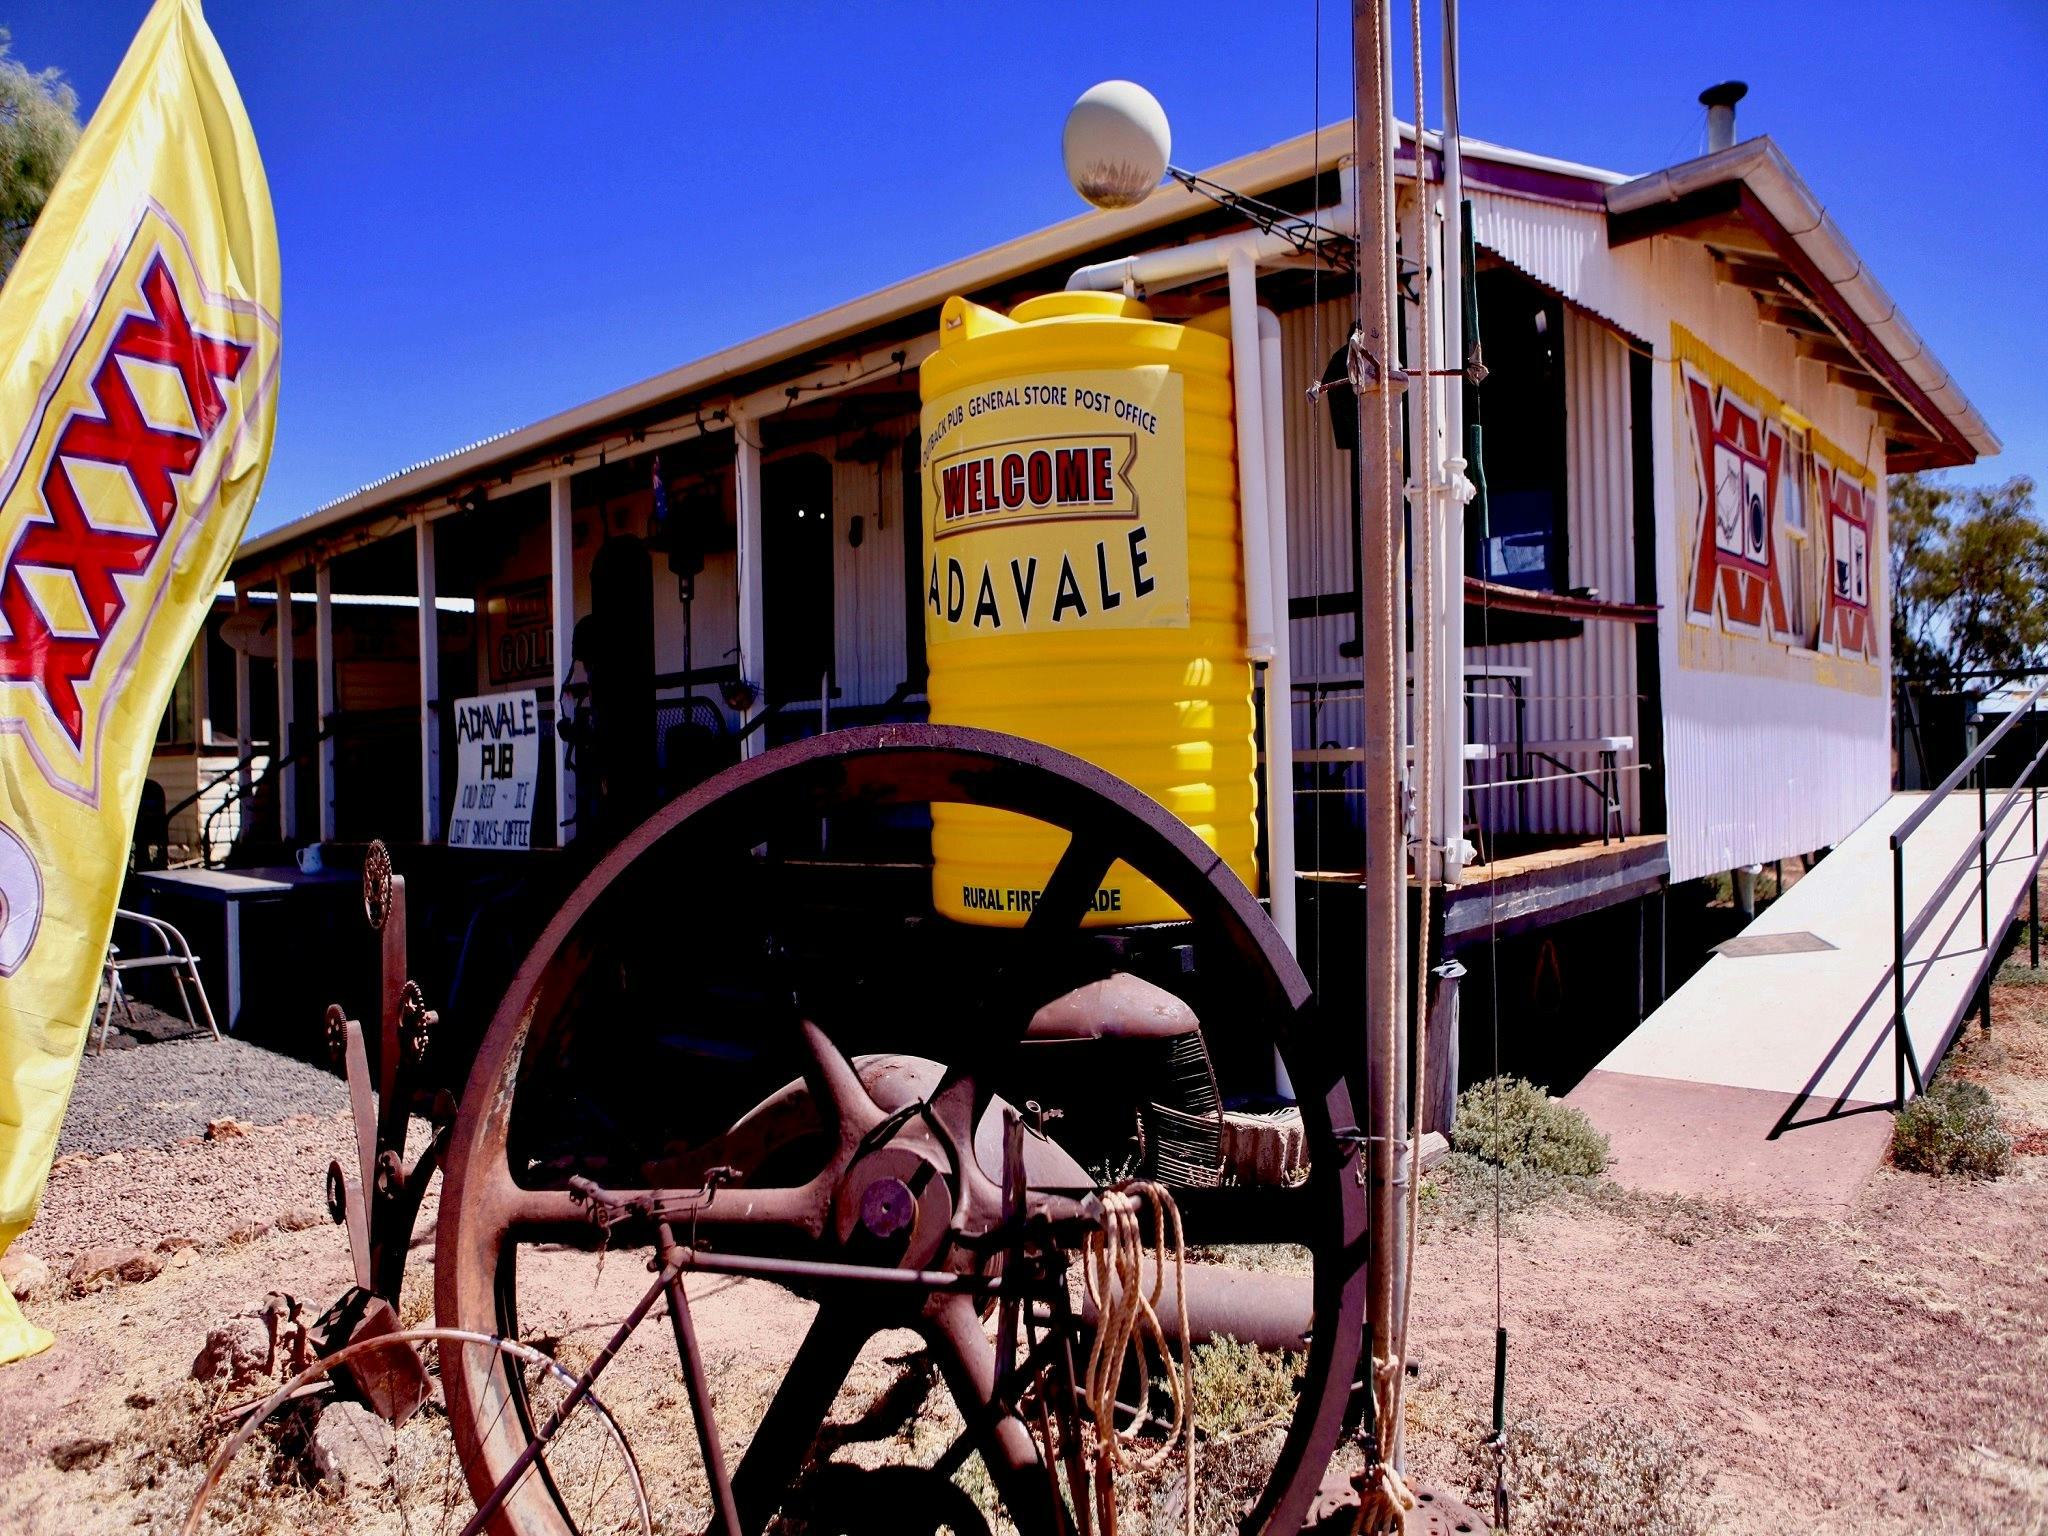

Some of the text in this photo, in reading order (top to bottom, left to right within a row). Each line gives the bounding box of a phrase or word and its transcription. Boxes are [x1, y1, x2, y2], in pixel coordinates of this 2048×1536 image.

[947, 405, 964, 430] PUB
[968, 387, 1020, 417] GENERAL
[1024, 385, 1067, 406] STORE
[1074, 388, 1110, 414] POST
[1114, 400, 1157, 435] OFFICE
[942, 447, 1115, 521] WELCOME
[928, 526, 1155, 628] ADAVALE
[457, 699, 537, 745] ADAVALE
[481, 743, 514, 780] PUB
[963, 886, 1004, 911] RURAL
